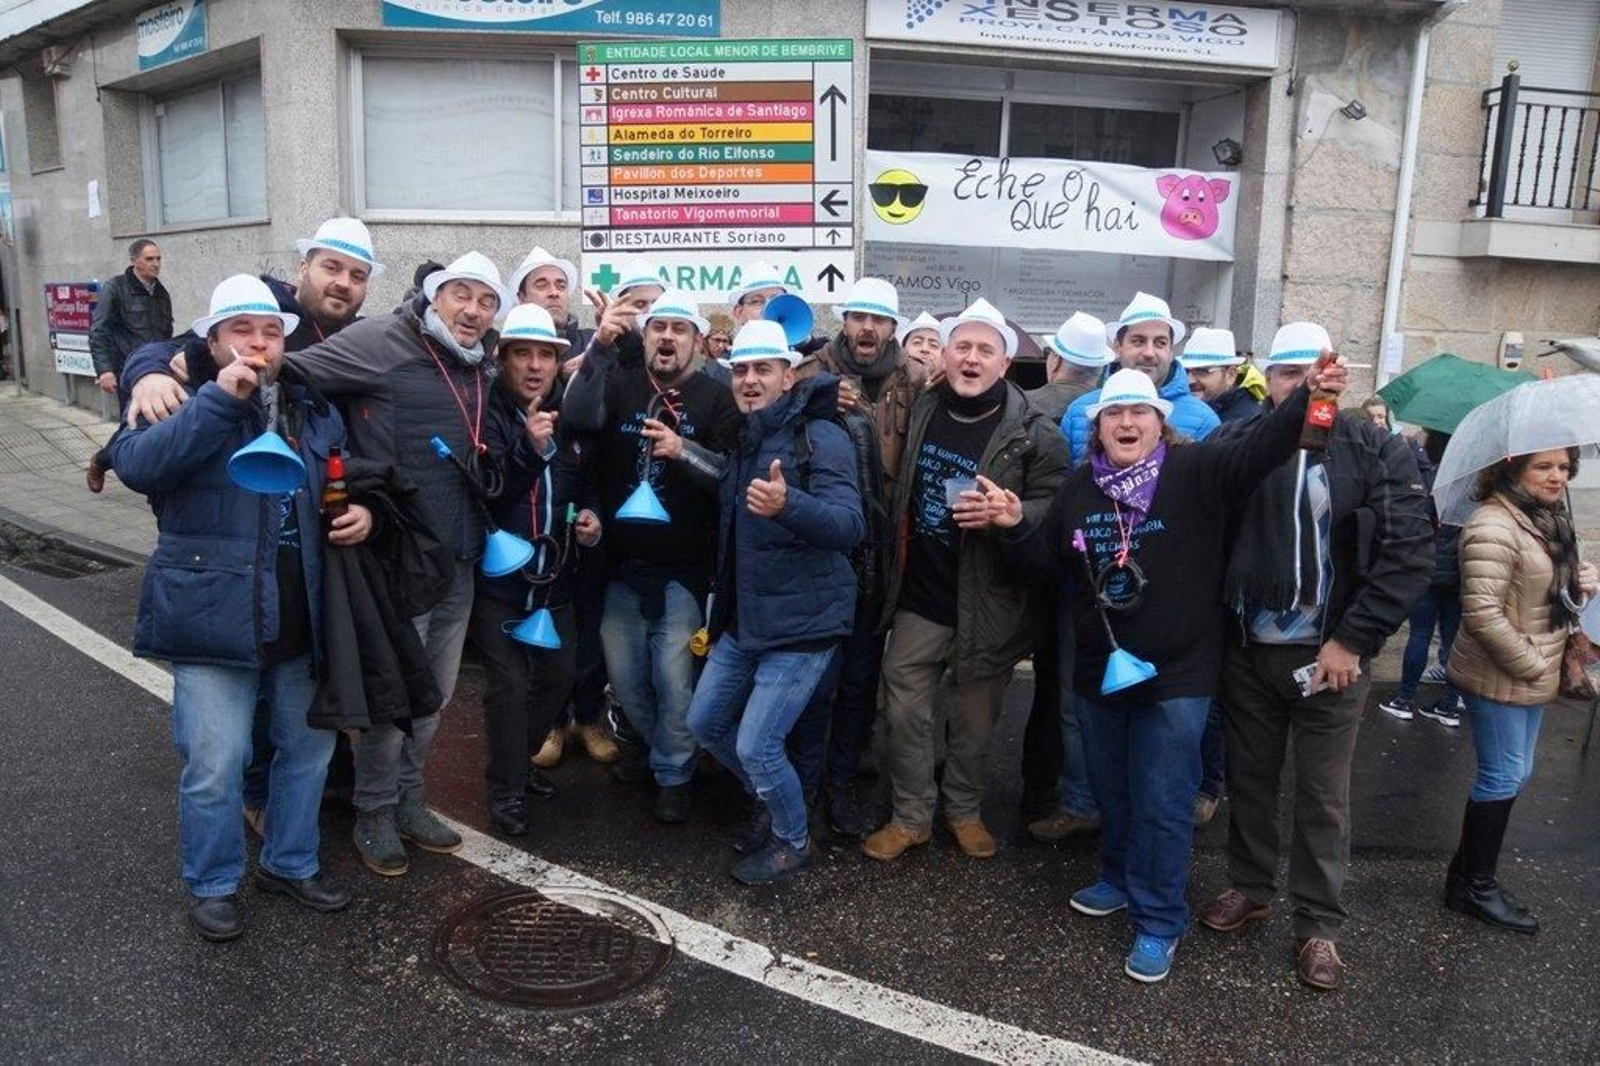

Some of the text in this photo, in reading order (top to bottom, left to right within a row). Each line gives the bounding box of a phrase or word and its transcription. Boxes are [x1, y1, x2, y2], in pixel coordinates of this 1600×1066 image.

[595, 10, 713, 27] Telf. 986 47 20 61
[959, 17, 1245, 46] PROYECTAMOS VIGO
[606, 44, 846, 59] ENTIDADE LOCAL MENOR DE BEMBRIVE
[611, 68, 657, 80] Centro
[661, 67, 679, 79] de
[611, 86, 718, 100] Centro Cultural
[611, 103, 807, 122] Igrexa Románica de Santiago
[613, 127, 753, 141] Alameda do Torreiro
[613, 148, 674, 161] Sendeiro
[678, 147, 695, 160] do
[670, 166, 695, 179] dos
[699, 166, 763, 180] Deportes
[954, 157, 1046, 201] Eche
[613, 187, 740, 202] Hospital Meixoeiro
[614, 206, 780, 222] Tanatorio Vigomemorial
[1085, 182, 1139, 232] hai
[615, 230, 786, 245] RESTAURANTE Soriano
[658, 264, 803, 291] ARMAA
[947, 278, 982, 295] Vigo
